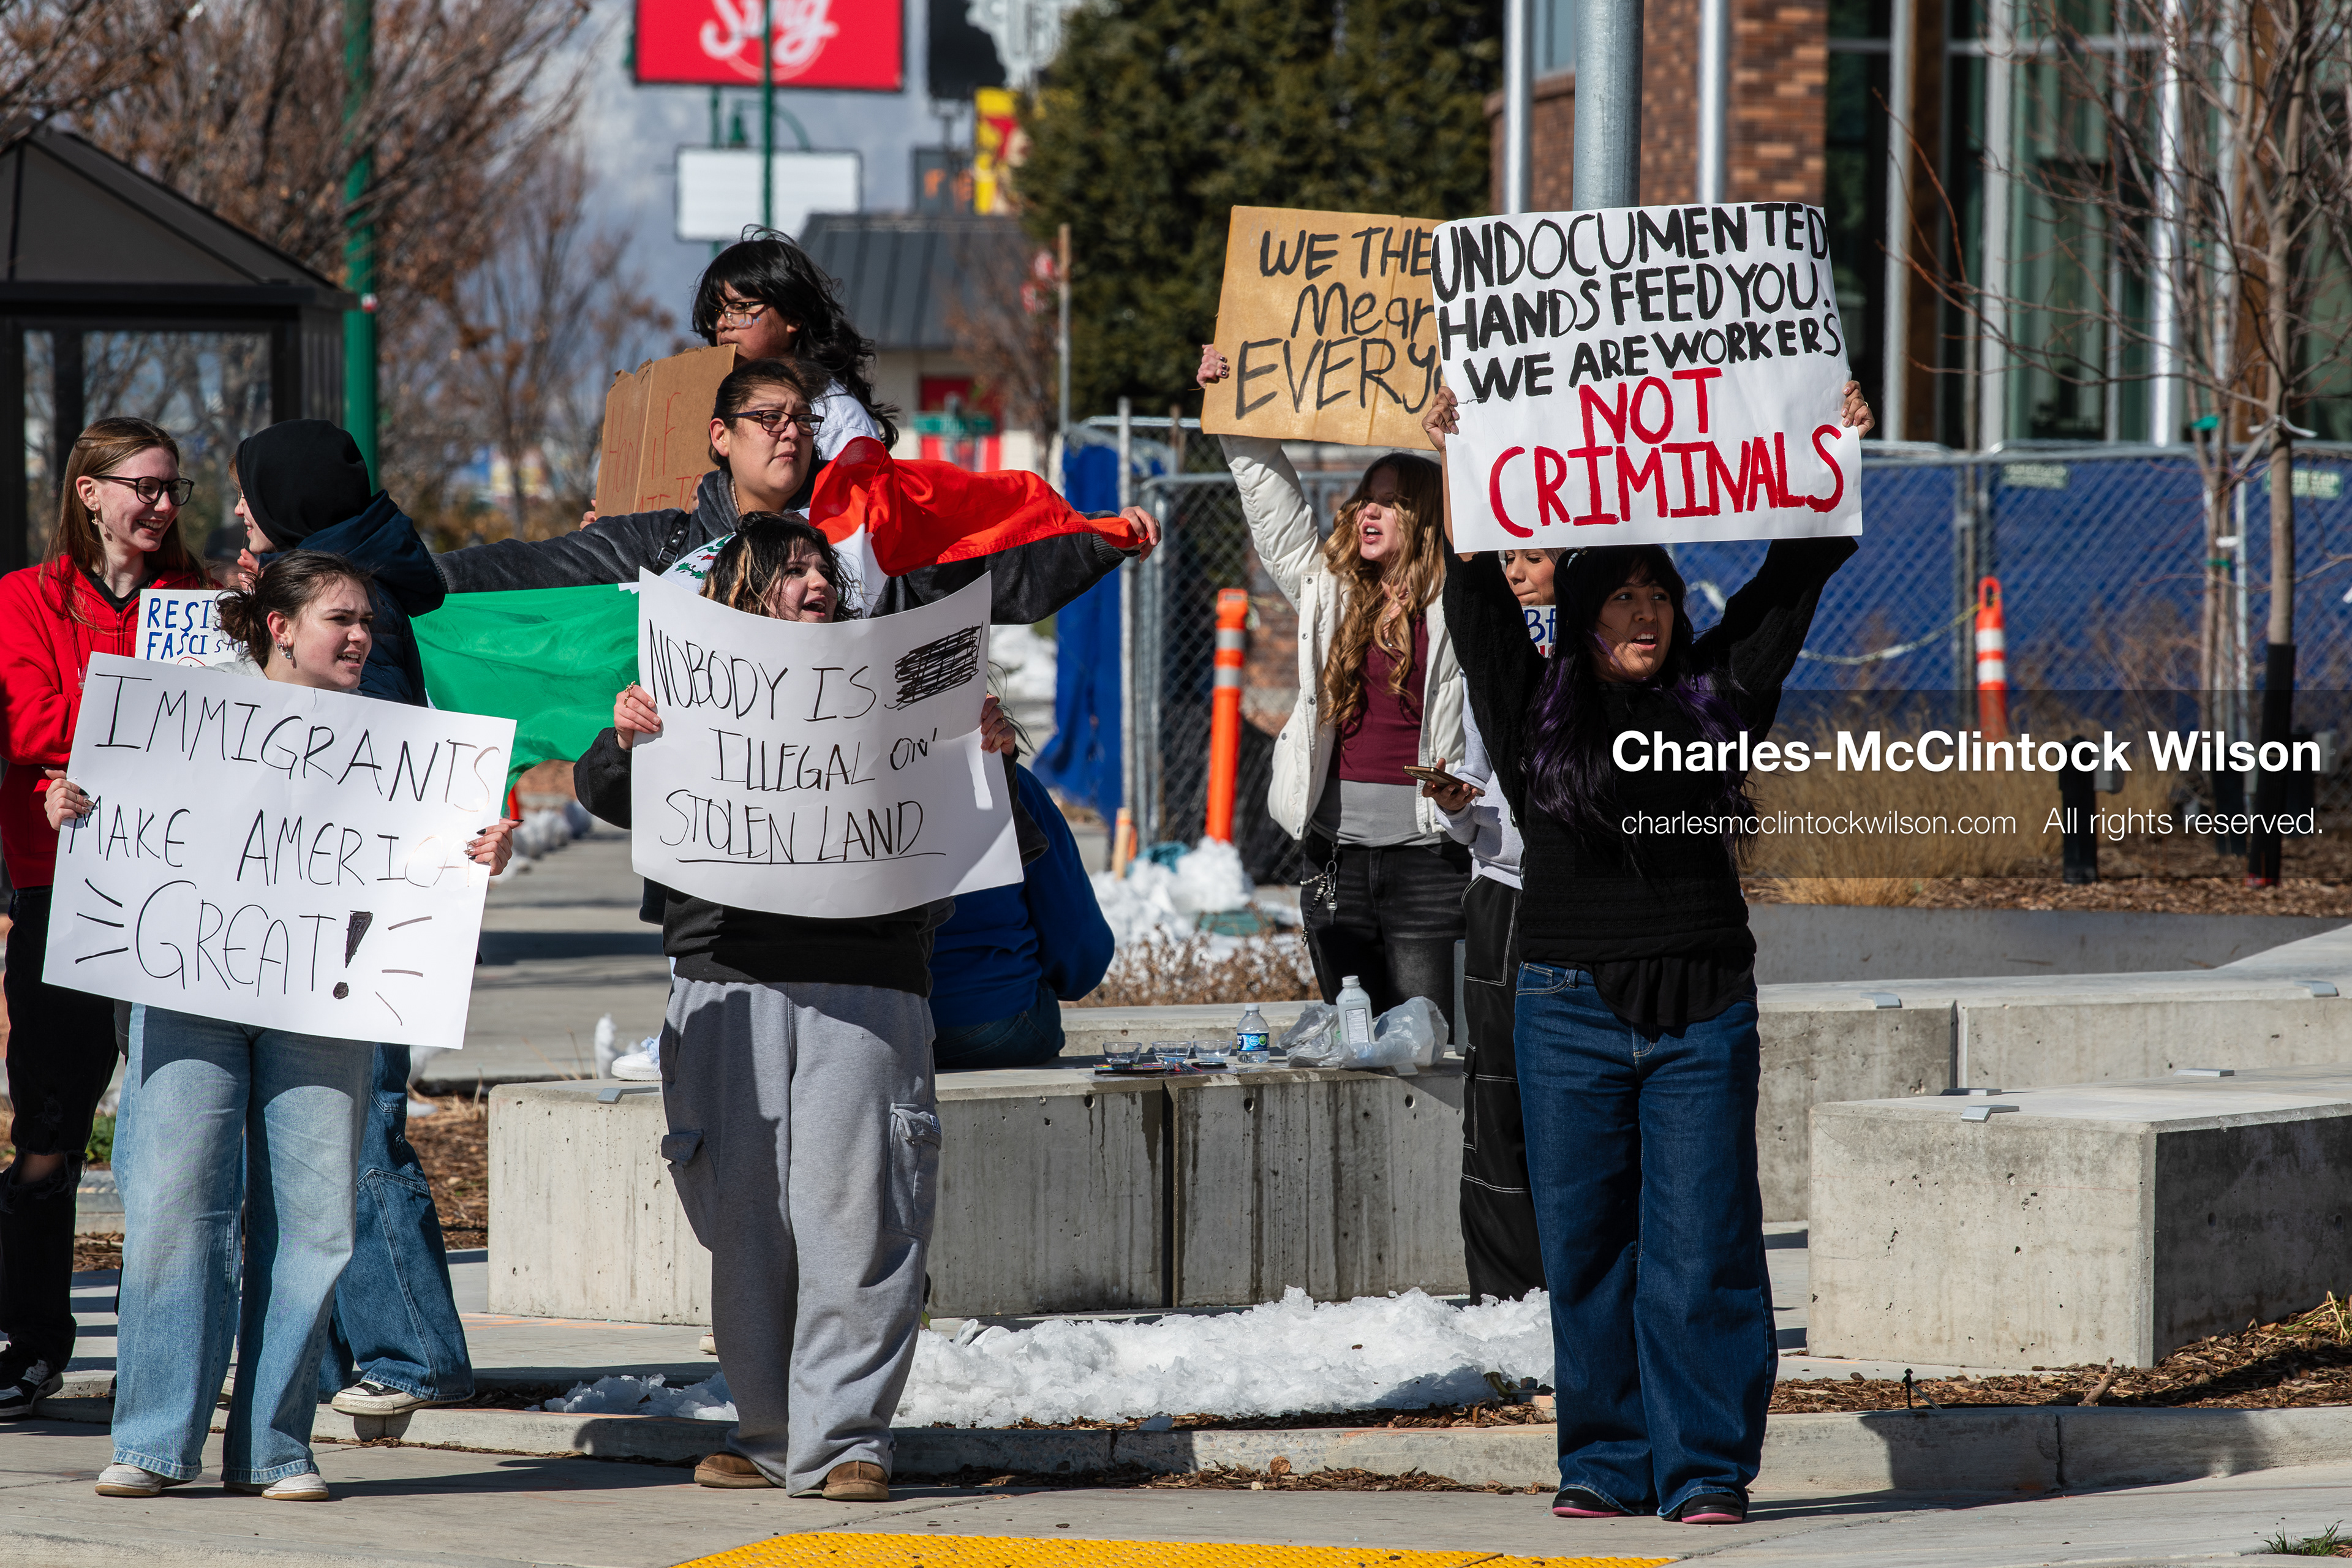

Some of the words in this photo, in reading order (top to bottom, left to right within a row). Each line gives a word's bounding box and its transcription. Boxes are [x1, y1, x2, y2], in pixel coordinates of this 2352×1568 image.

[1260, 228, 1340, 281] WE
[1351, 226, 1433, 279] THE
[1431, 203, 1830, 303] UNDOCUMENTED
[1439, 279, 1601, 361] HANDS
[1610, 263, 1724, 326] FEED
[1725, 261, 1831, 318] YOU.
[1463, 352, 1554, 403] WE
[1568, 335, 1649, 388] ARE
[1650, 312, 1841, 369] WORKERS
[1578, 367, 1723, 448] NOT
[1488, 424, 1844, 538] CRIMINALS
[147, 597, 219, 631] RESI
[649, 619, 788, 720] NOBODY
[803, 665, 877, 722] IS
[94, 673, 500, 813] IMMIGRANTS
[709, 728, 876, 792] ILLEGAL
[68, 794, 191, 868] MAKE
[236, 809, 471, 887] AMERICA
[660, 789, 796, 864] STOLEN
[817, 800, 924, 862] LAND
[135, 880, 374, 1000] GREAT!
